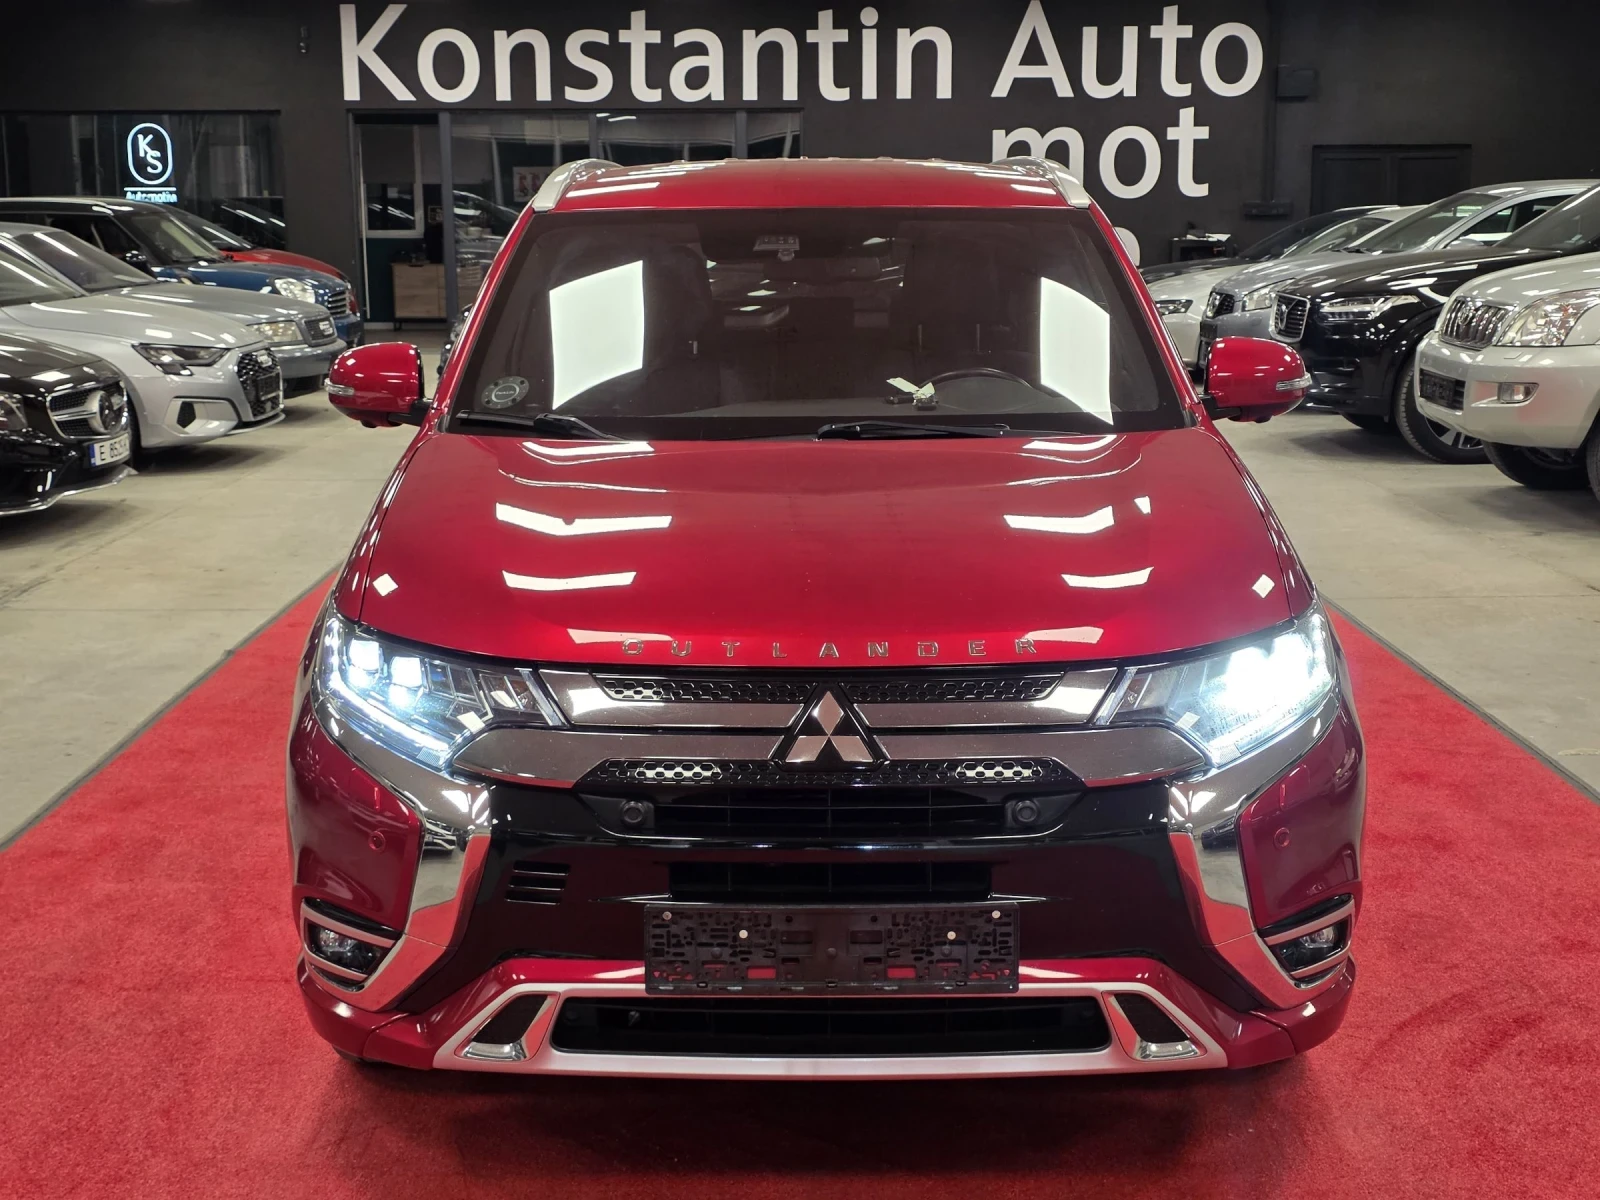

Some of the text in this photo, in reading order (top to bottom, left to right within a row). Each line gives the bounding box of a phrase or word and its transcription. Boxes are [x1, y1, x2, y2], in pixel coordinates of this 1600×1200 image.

[340, 1, 1264, 103] Konstantin Auto
[621, 638, 1038, 659] OUTLANDER
